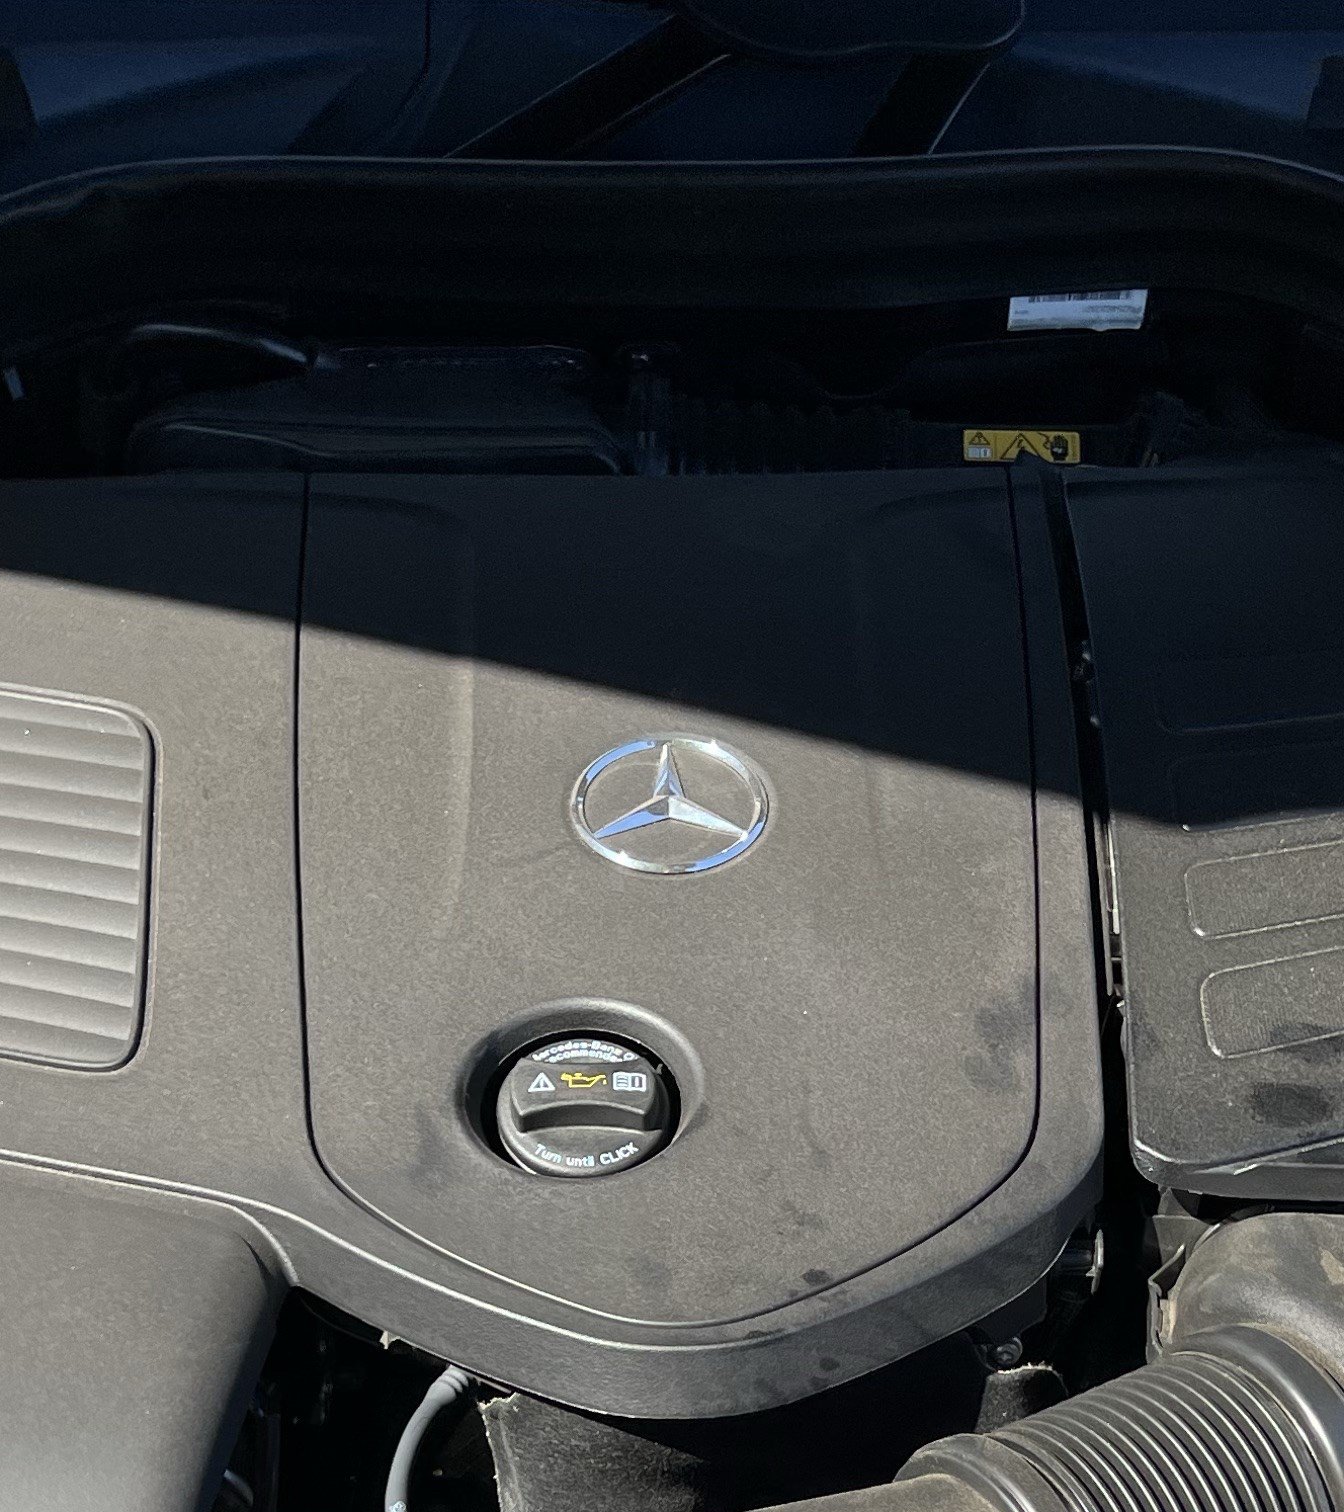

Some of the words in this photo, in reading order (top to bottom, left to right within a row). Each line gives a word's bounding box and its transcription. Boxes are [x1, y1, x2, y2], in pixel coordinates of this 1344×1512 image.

[534, 1143, 562, 1164] Turn
[566, 1155, 595, 1167] until
[599, 1141, 639, 1165] CLICK
